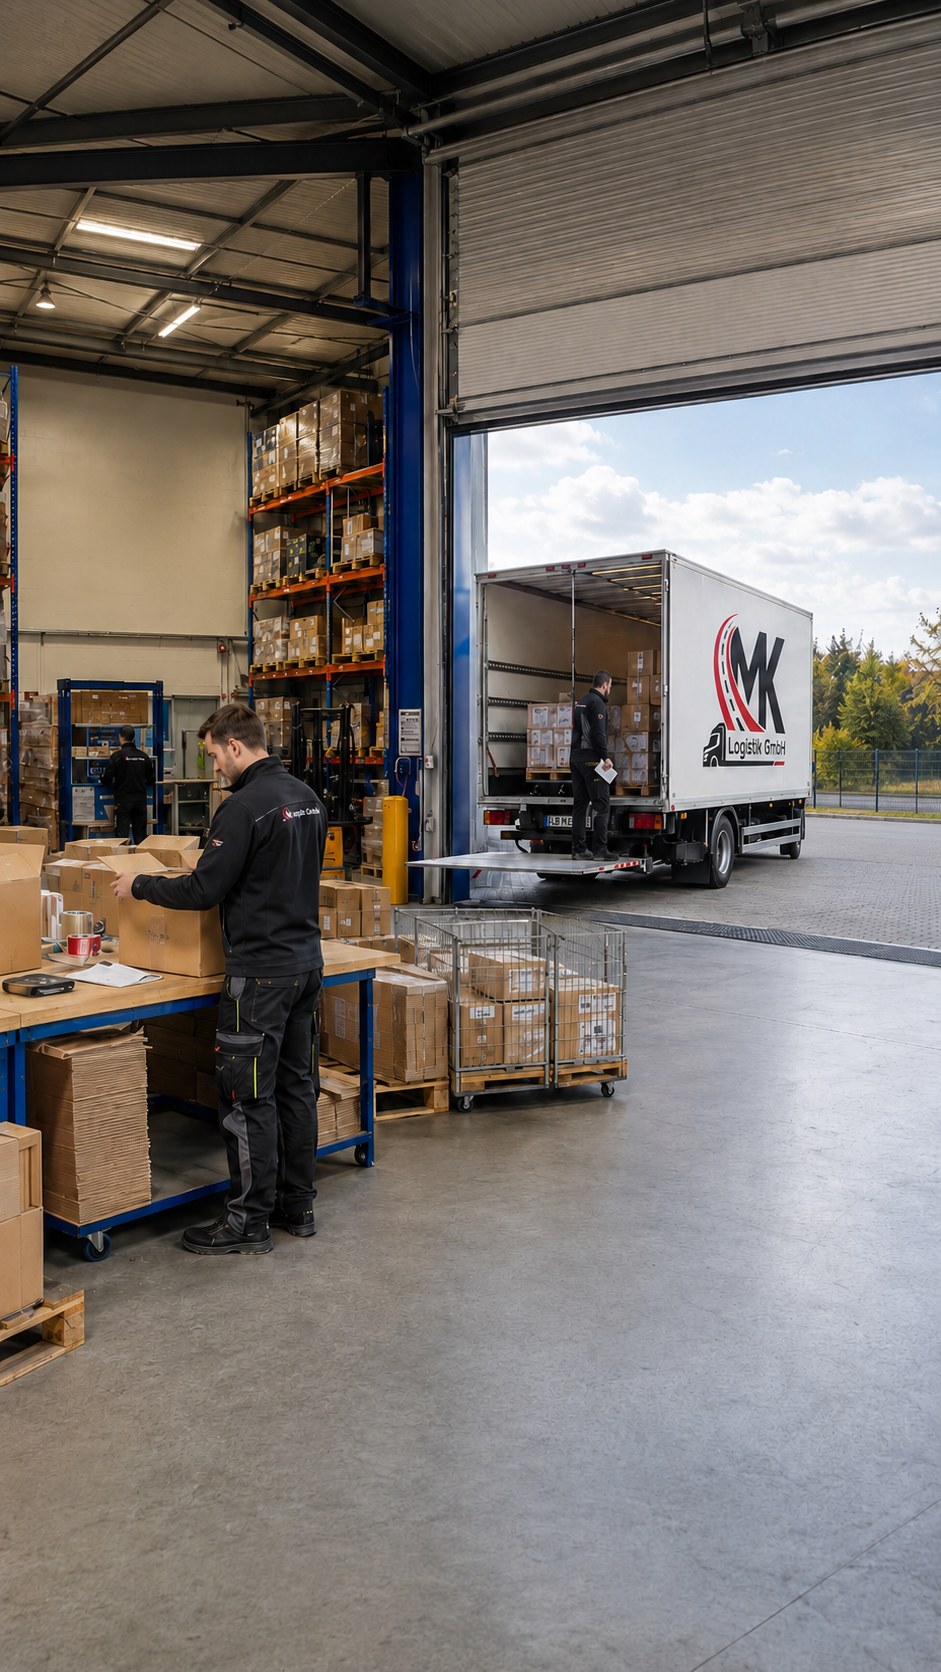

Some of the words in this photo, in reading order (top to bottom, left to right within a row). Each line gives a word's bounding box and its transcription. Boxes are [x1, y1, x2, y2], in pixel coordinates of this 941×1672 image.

[730, 626, 785, 734] MK
[728, 736, 762, 760] Logistik
[764, 738, 786, 756] GmbH
